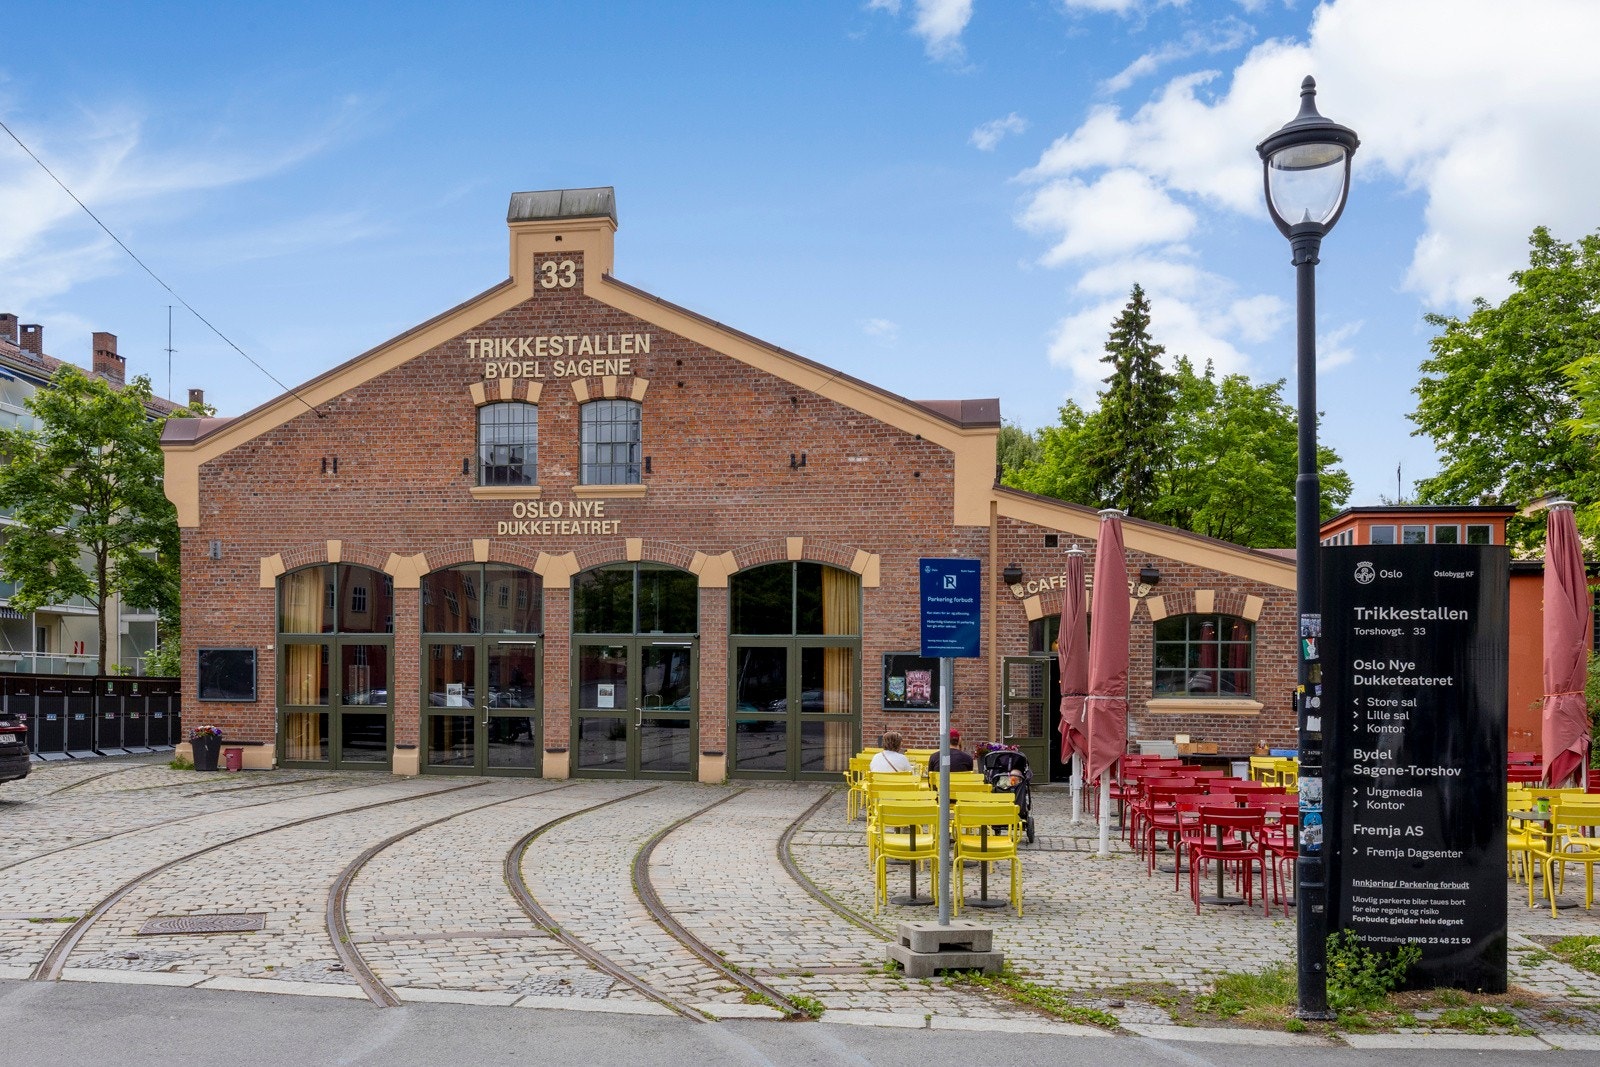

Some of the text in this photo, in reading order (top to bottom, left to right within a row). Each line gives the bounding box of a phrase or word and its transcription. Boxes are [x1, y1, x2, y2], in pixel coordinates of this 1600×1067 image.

[541, 260, 577, 288] 33
[466, 334, 651, 358] TRIKKESTALLEN
[485, 359, 631, 378] BYDEL SAGENE
[513, 501, 604, 518] OSLO NYE
[498, 520, 620, 536] DUKKETEATRET
[1380, 570, 1402, 578] Oslo
[1434, 570, 1465, 578] Oslobygg
[1354, 607, 1468, 620] Trikkestallen
[1354, 628, 1404, 637] Torshovgt.
[1354, 660, 1415, 672] Oslo Nye
[1354, 675, 1453, 686] Dukketeateret
[1367, 698, 1417, 707] Store sal
[1367, 711, 1409, 720] Lille sal
[1367, 724, 1405, 733] Kontor
[1354, 749, 1392, 762] Bydel
[1353, 765, 1461, 778] Sagene-Torshov
[1367, 787, 1423, 799] Ungmedia
[1367, 801, 1405, 810] Kontor
[1353, 825, 1424, 838] Fremja AS
[1367, 847, 1463, 860] Fremja Dagsenter
[1352, 879, 1469, 889] Innkjøring/ Parkering forbudt
[1352, 896, 1377, 904] Ulovlig
[1412, 898, 1429, 906] biler
[1381, 907, 1408, 915] regning
[1353, 915, 1388, 923] Forbudet
[1368, 935, 1405, 944] borttauing
